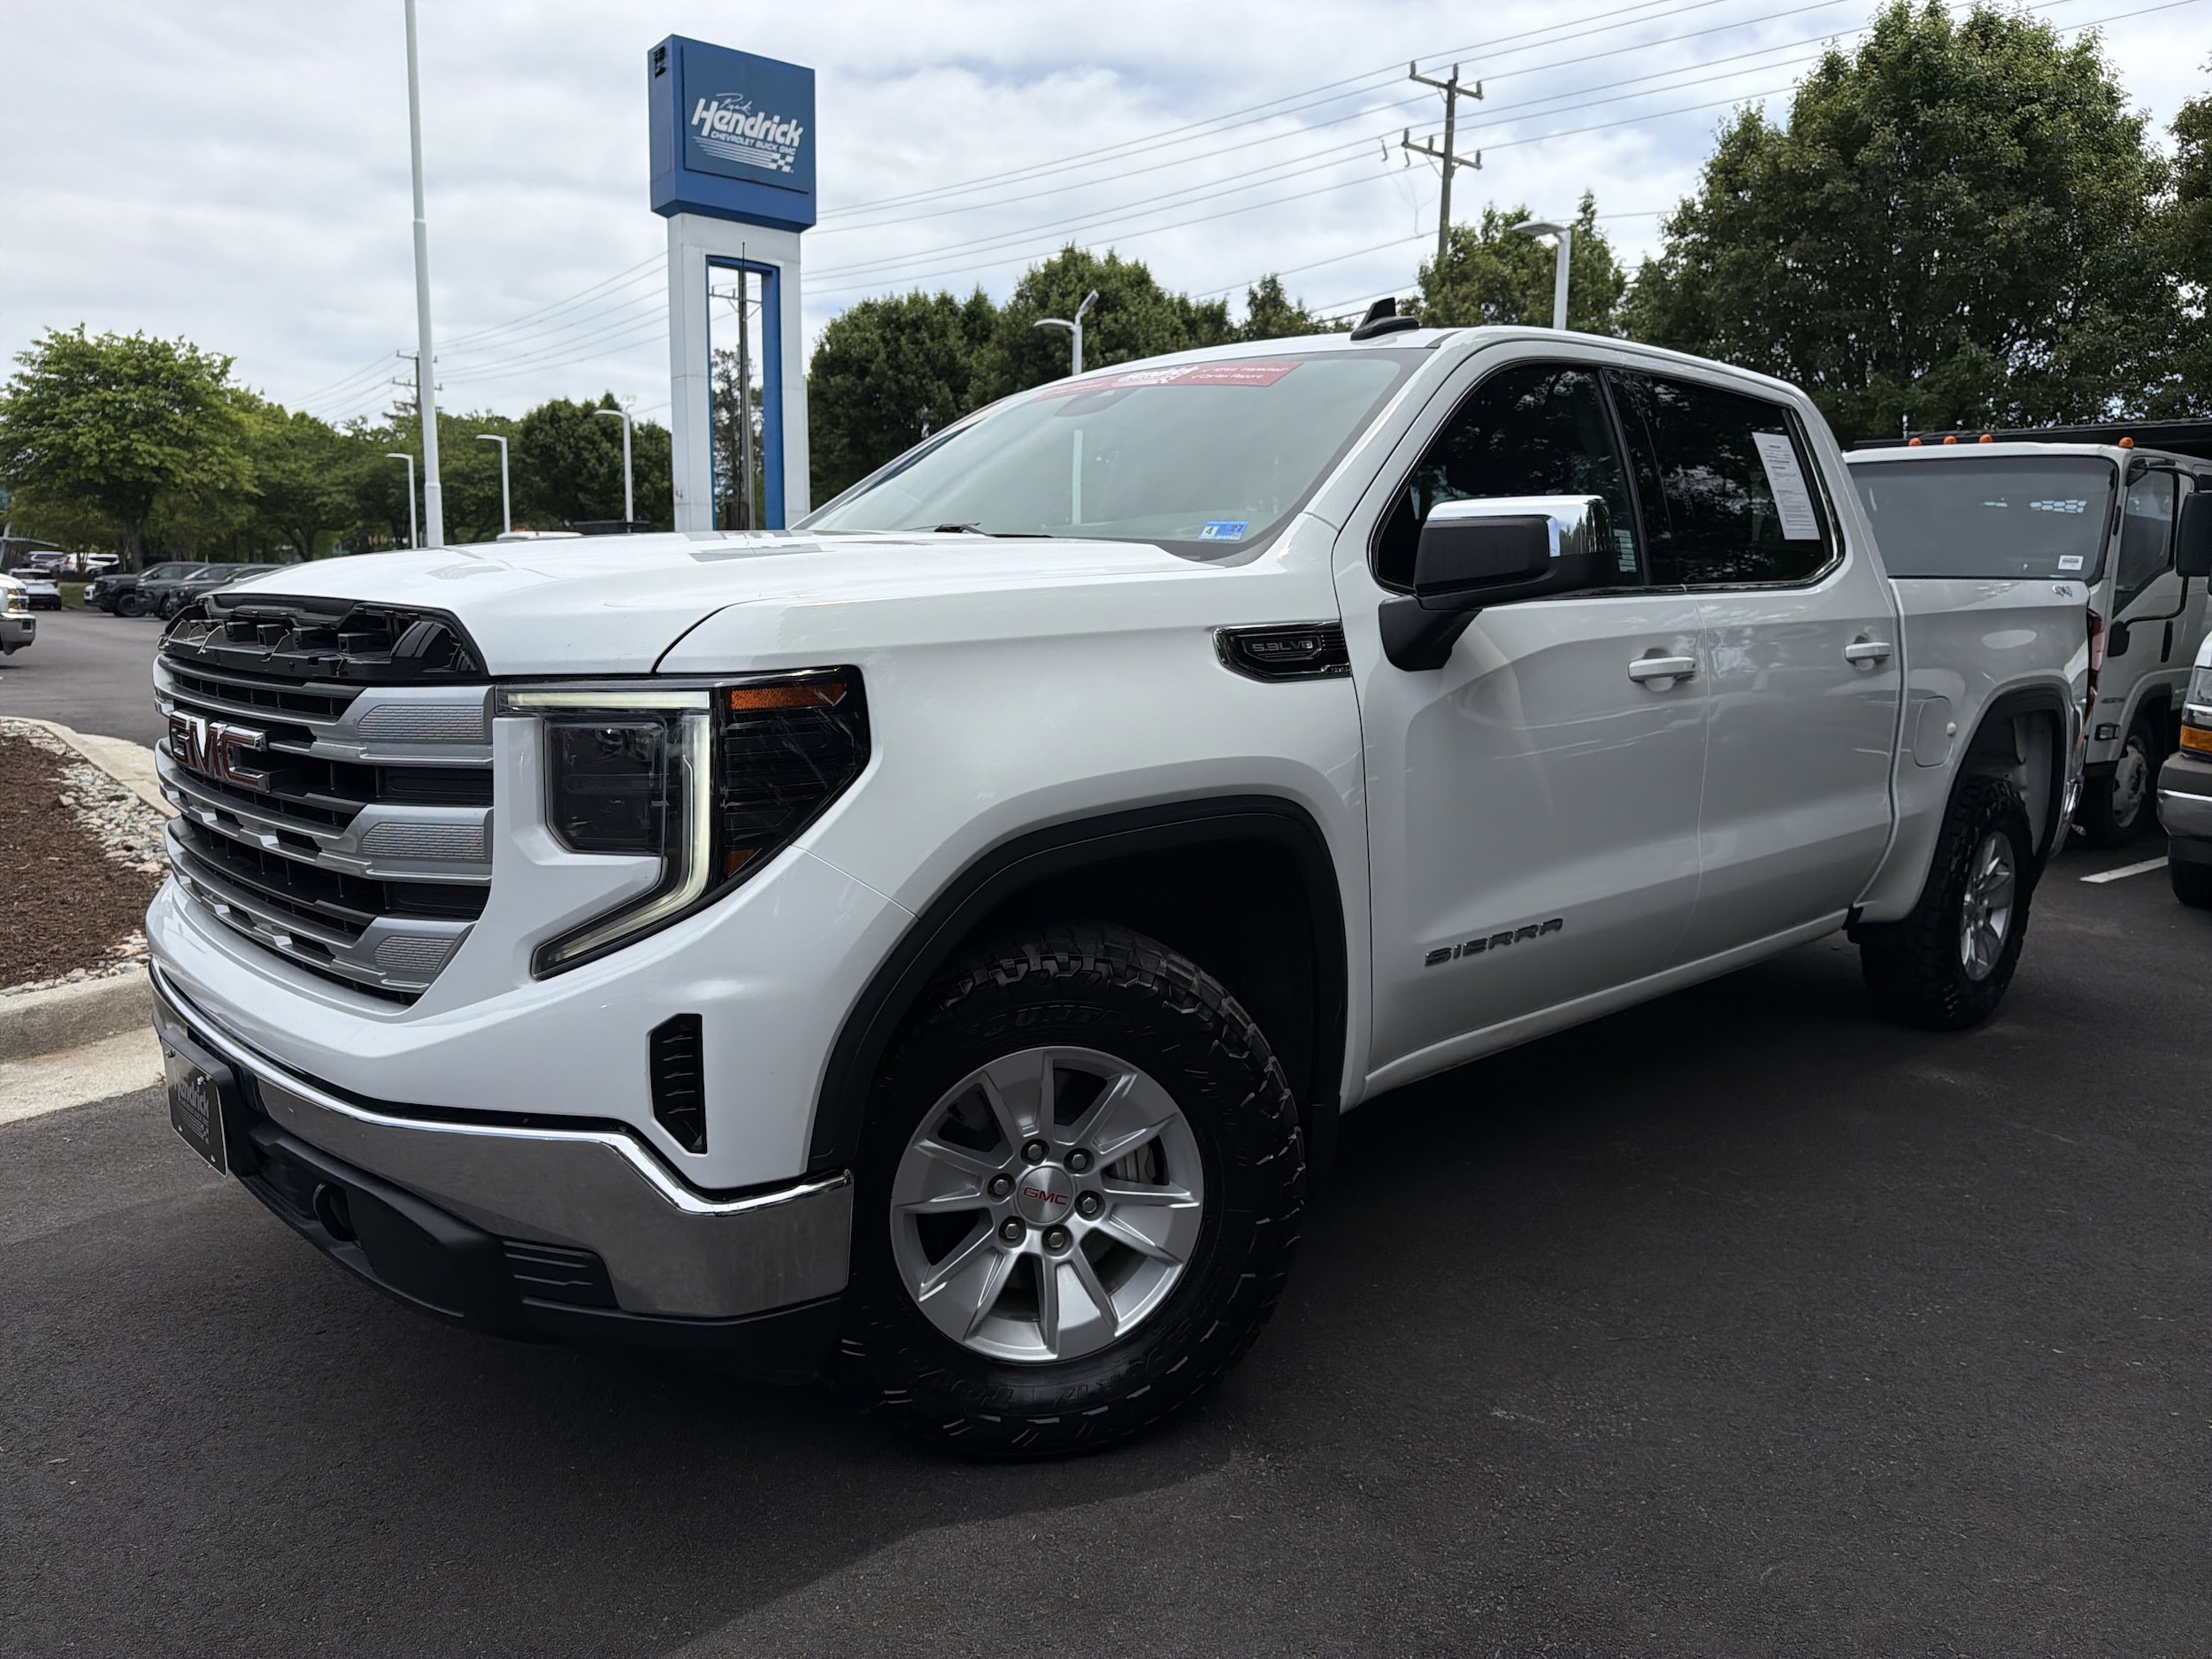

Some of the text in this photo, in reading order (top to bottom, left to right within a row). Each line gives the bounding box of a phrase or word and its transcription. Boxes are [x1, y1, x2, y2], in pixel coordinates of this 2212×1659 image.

[691, 98, 803, 148] Hendrick
[710, 132, 797, 154] CHEVROLET BUICK GMC
[168, 710, 270, 794] GMC
[1425, 918, 1563, 967] SIERRA
[1024, 1187, 1069, 1205] GMC
